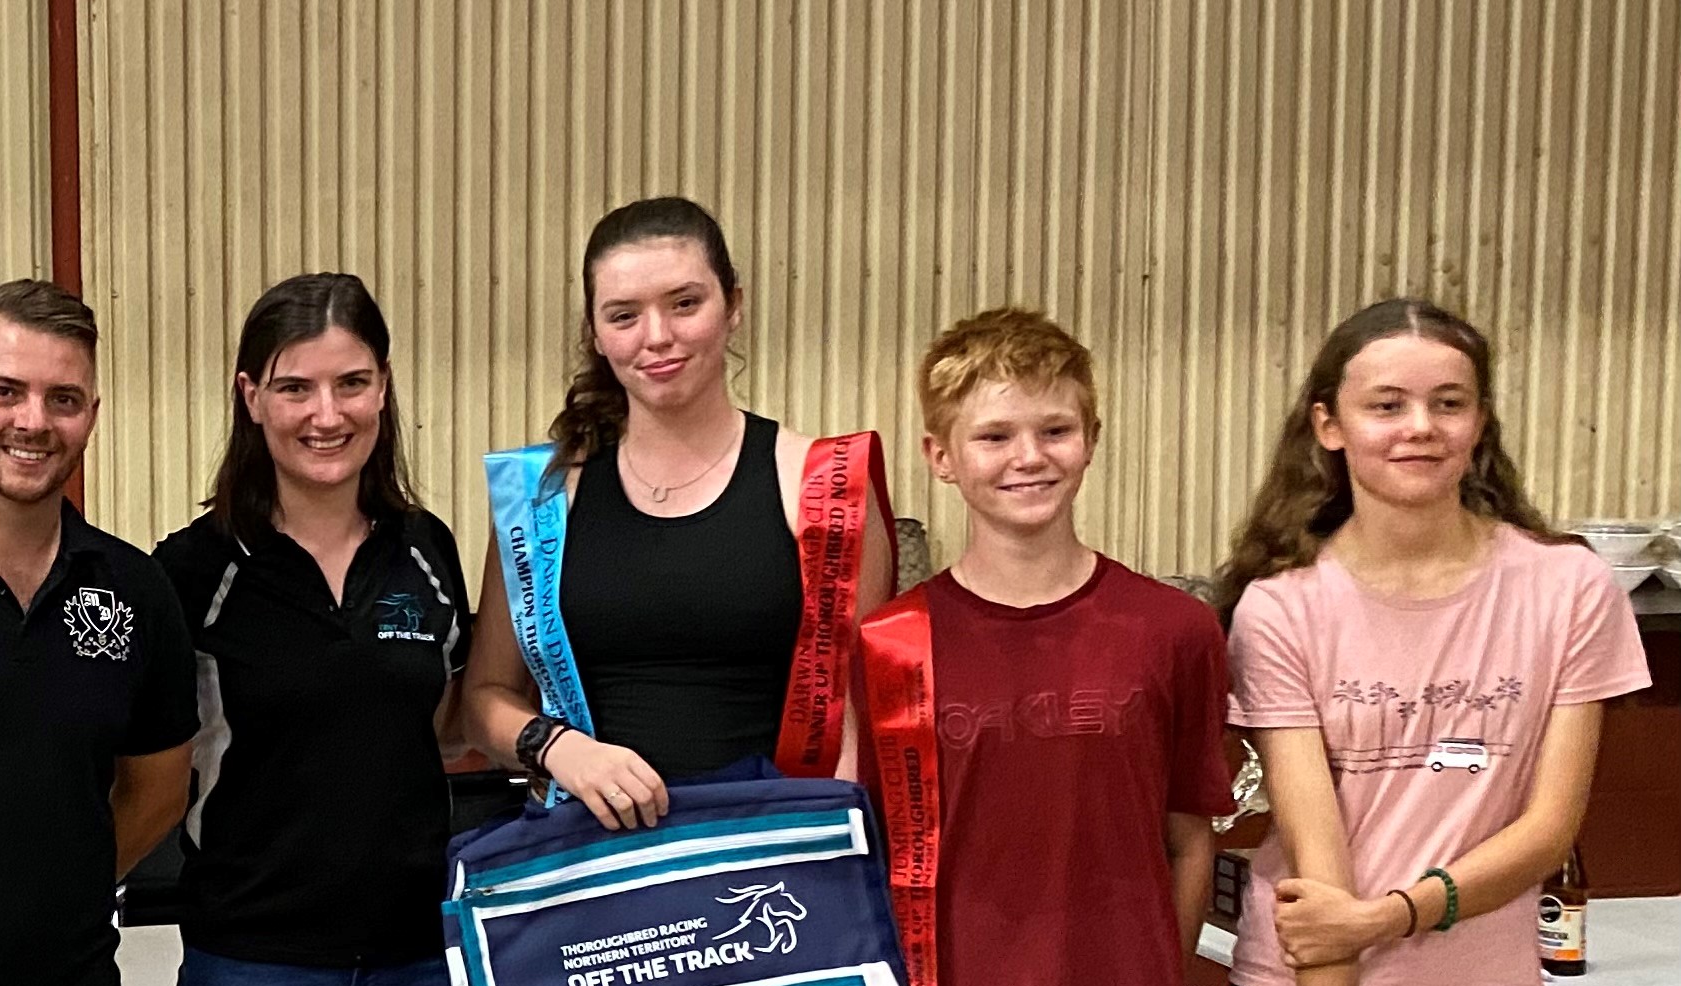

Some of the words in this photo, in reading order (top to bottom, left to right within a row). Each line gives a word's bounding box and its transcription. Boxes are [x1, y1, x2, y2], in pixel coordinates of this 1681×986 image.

[805, 475, 825, 523] CLUB
[510, 526, 536, 618] CHAMPION
[540, 537, 559, 635] DARWIN
[560, 927, 658, 957] THOROUGHBRED
[659, 917, 707, 937] RACING
[563, 946, 630, 970] NORTHERN
[630, 933, 697, 957] TERRITORY
[616, 959, 669, 985] THE
[669, 941, 755, 974] TRACK
